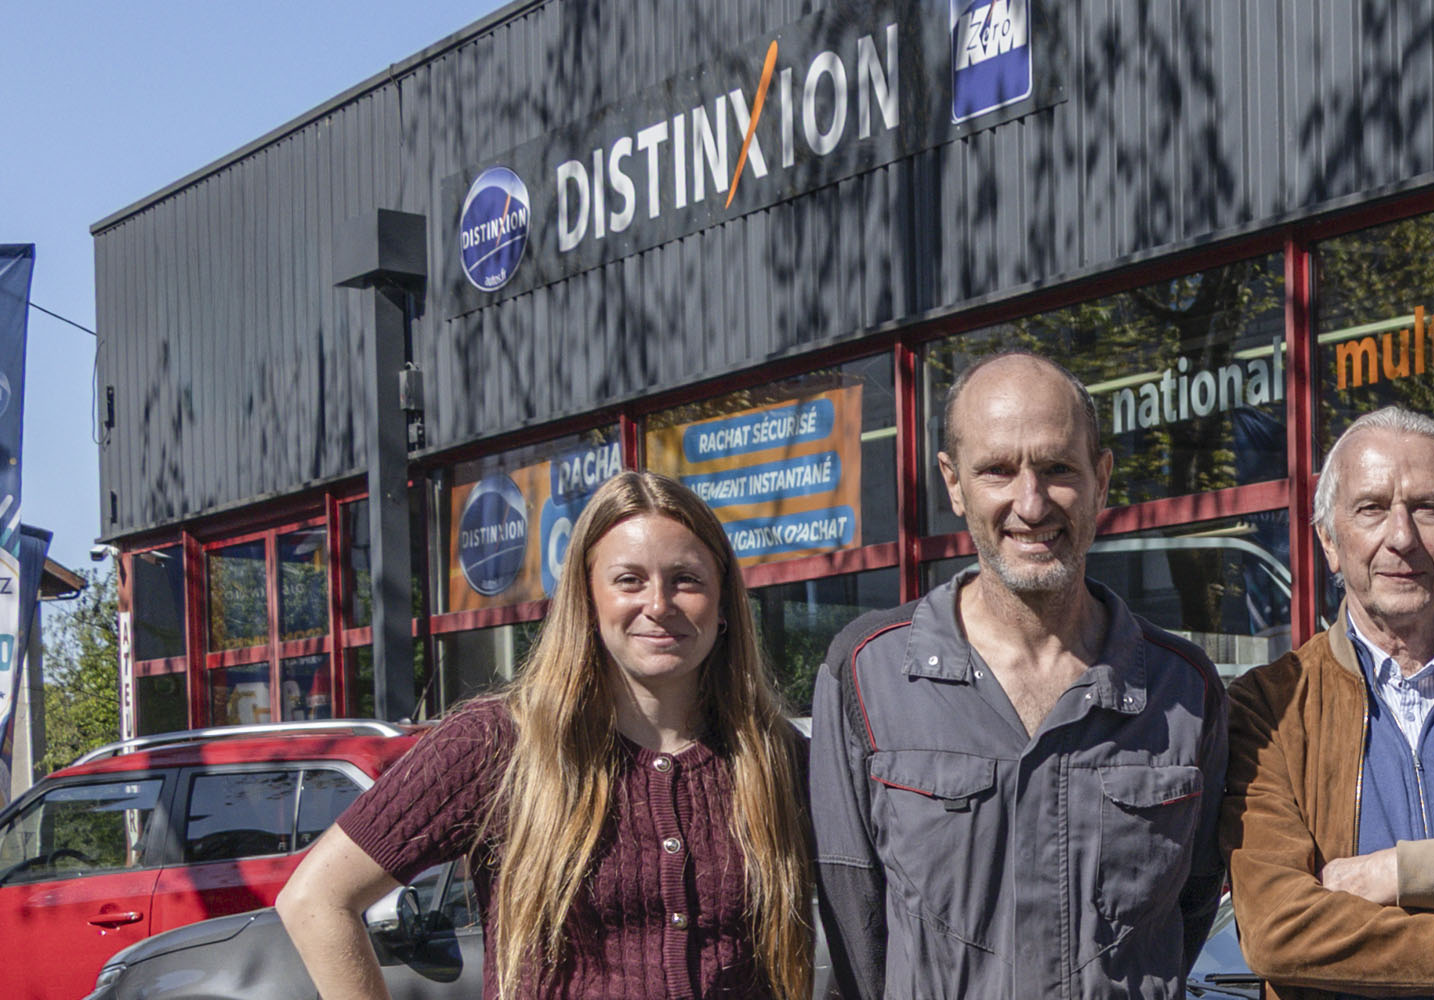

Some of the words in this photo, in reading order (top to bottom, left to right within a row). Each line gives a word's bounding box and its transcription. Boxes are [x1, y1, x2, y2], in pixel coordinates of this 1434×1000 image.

[956, 0, 1027, 71] KM
[967, 18, 1011, 51] Zero
[557, 23, 899, 253] DISTINXION
[462, 206, 526, 250] DISTINXION
[1111, 335, 1284, 434] national
[698, 425, 751, 453] RACHAT
[752, 406, 817, 444] SÉCURISÉ
[558, 442, 622, 495] RACHA
[691, 477, 747, 500] IEMENT
[749, 455, 831, 496] INSTANTANÉ
[462, 518, 525, 549] DISTINXION
[728, 524, 783, 551] IGATION
